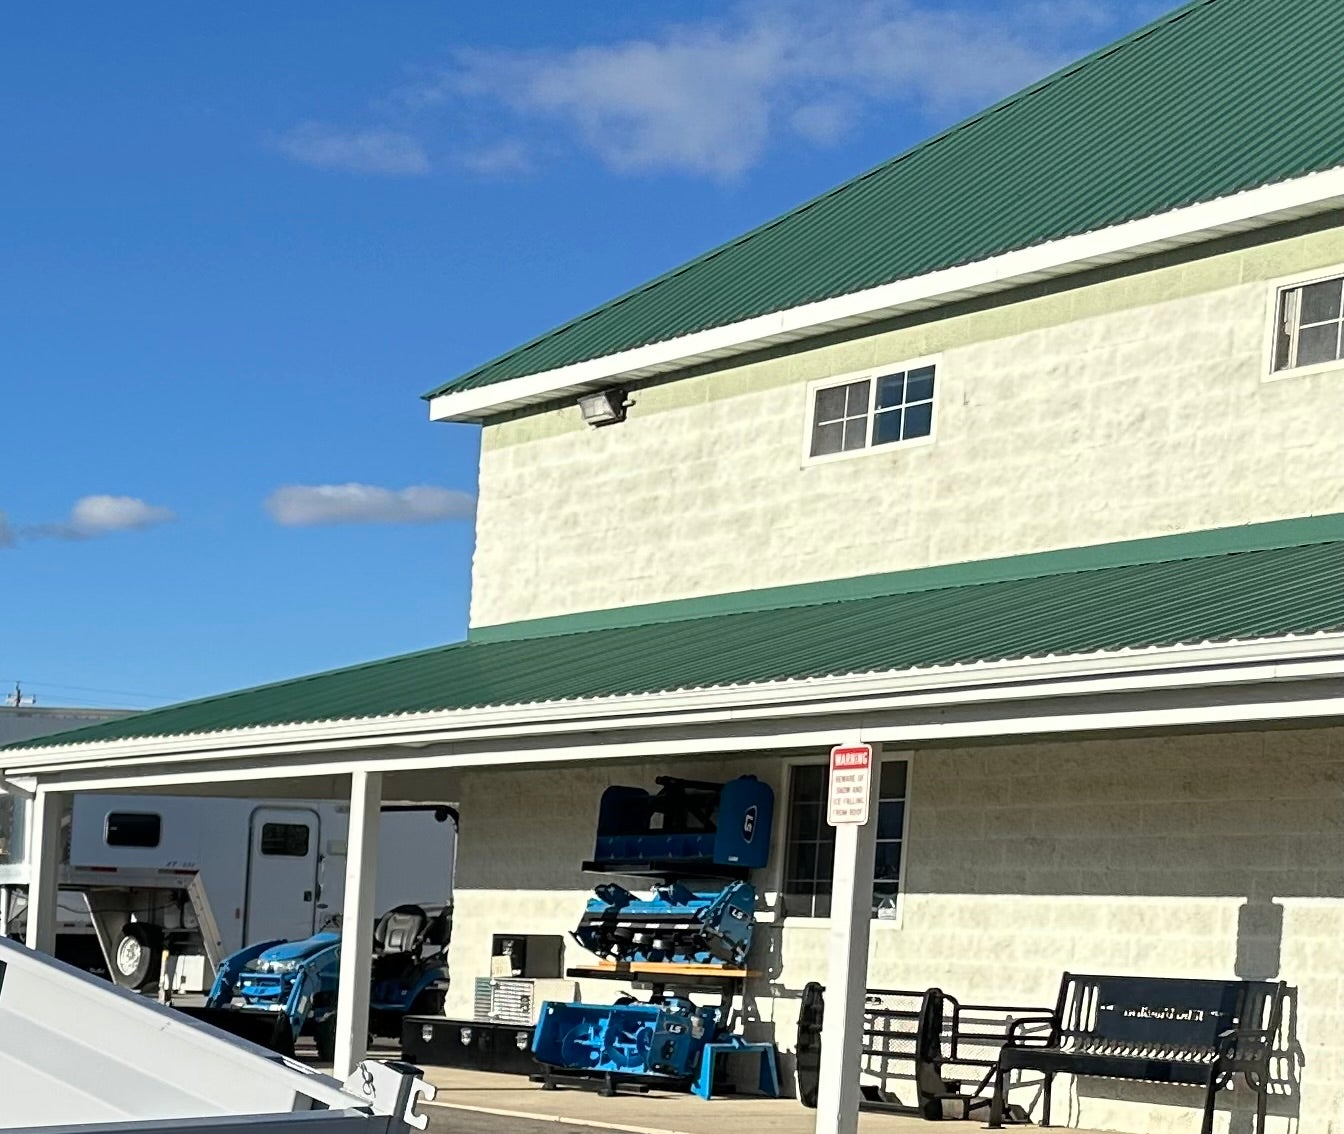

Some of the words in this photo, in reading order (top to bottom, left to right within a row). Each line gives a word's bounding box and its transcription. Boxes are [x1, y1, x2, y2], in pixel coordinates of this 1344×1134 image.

[834, 752, 868, 767] WARNING
[732, 909, 743, 920] LS
[669, 1024, 682, 1034] LS
